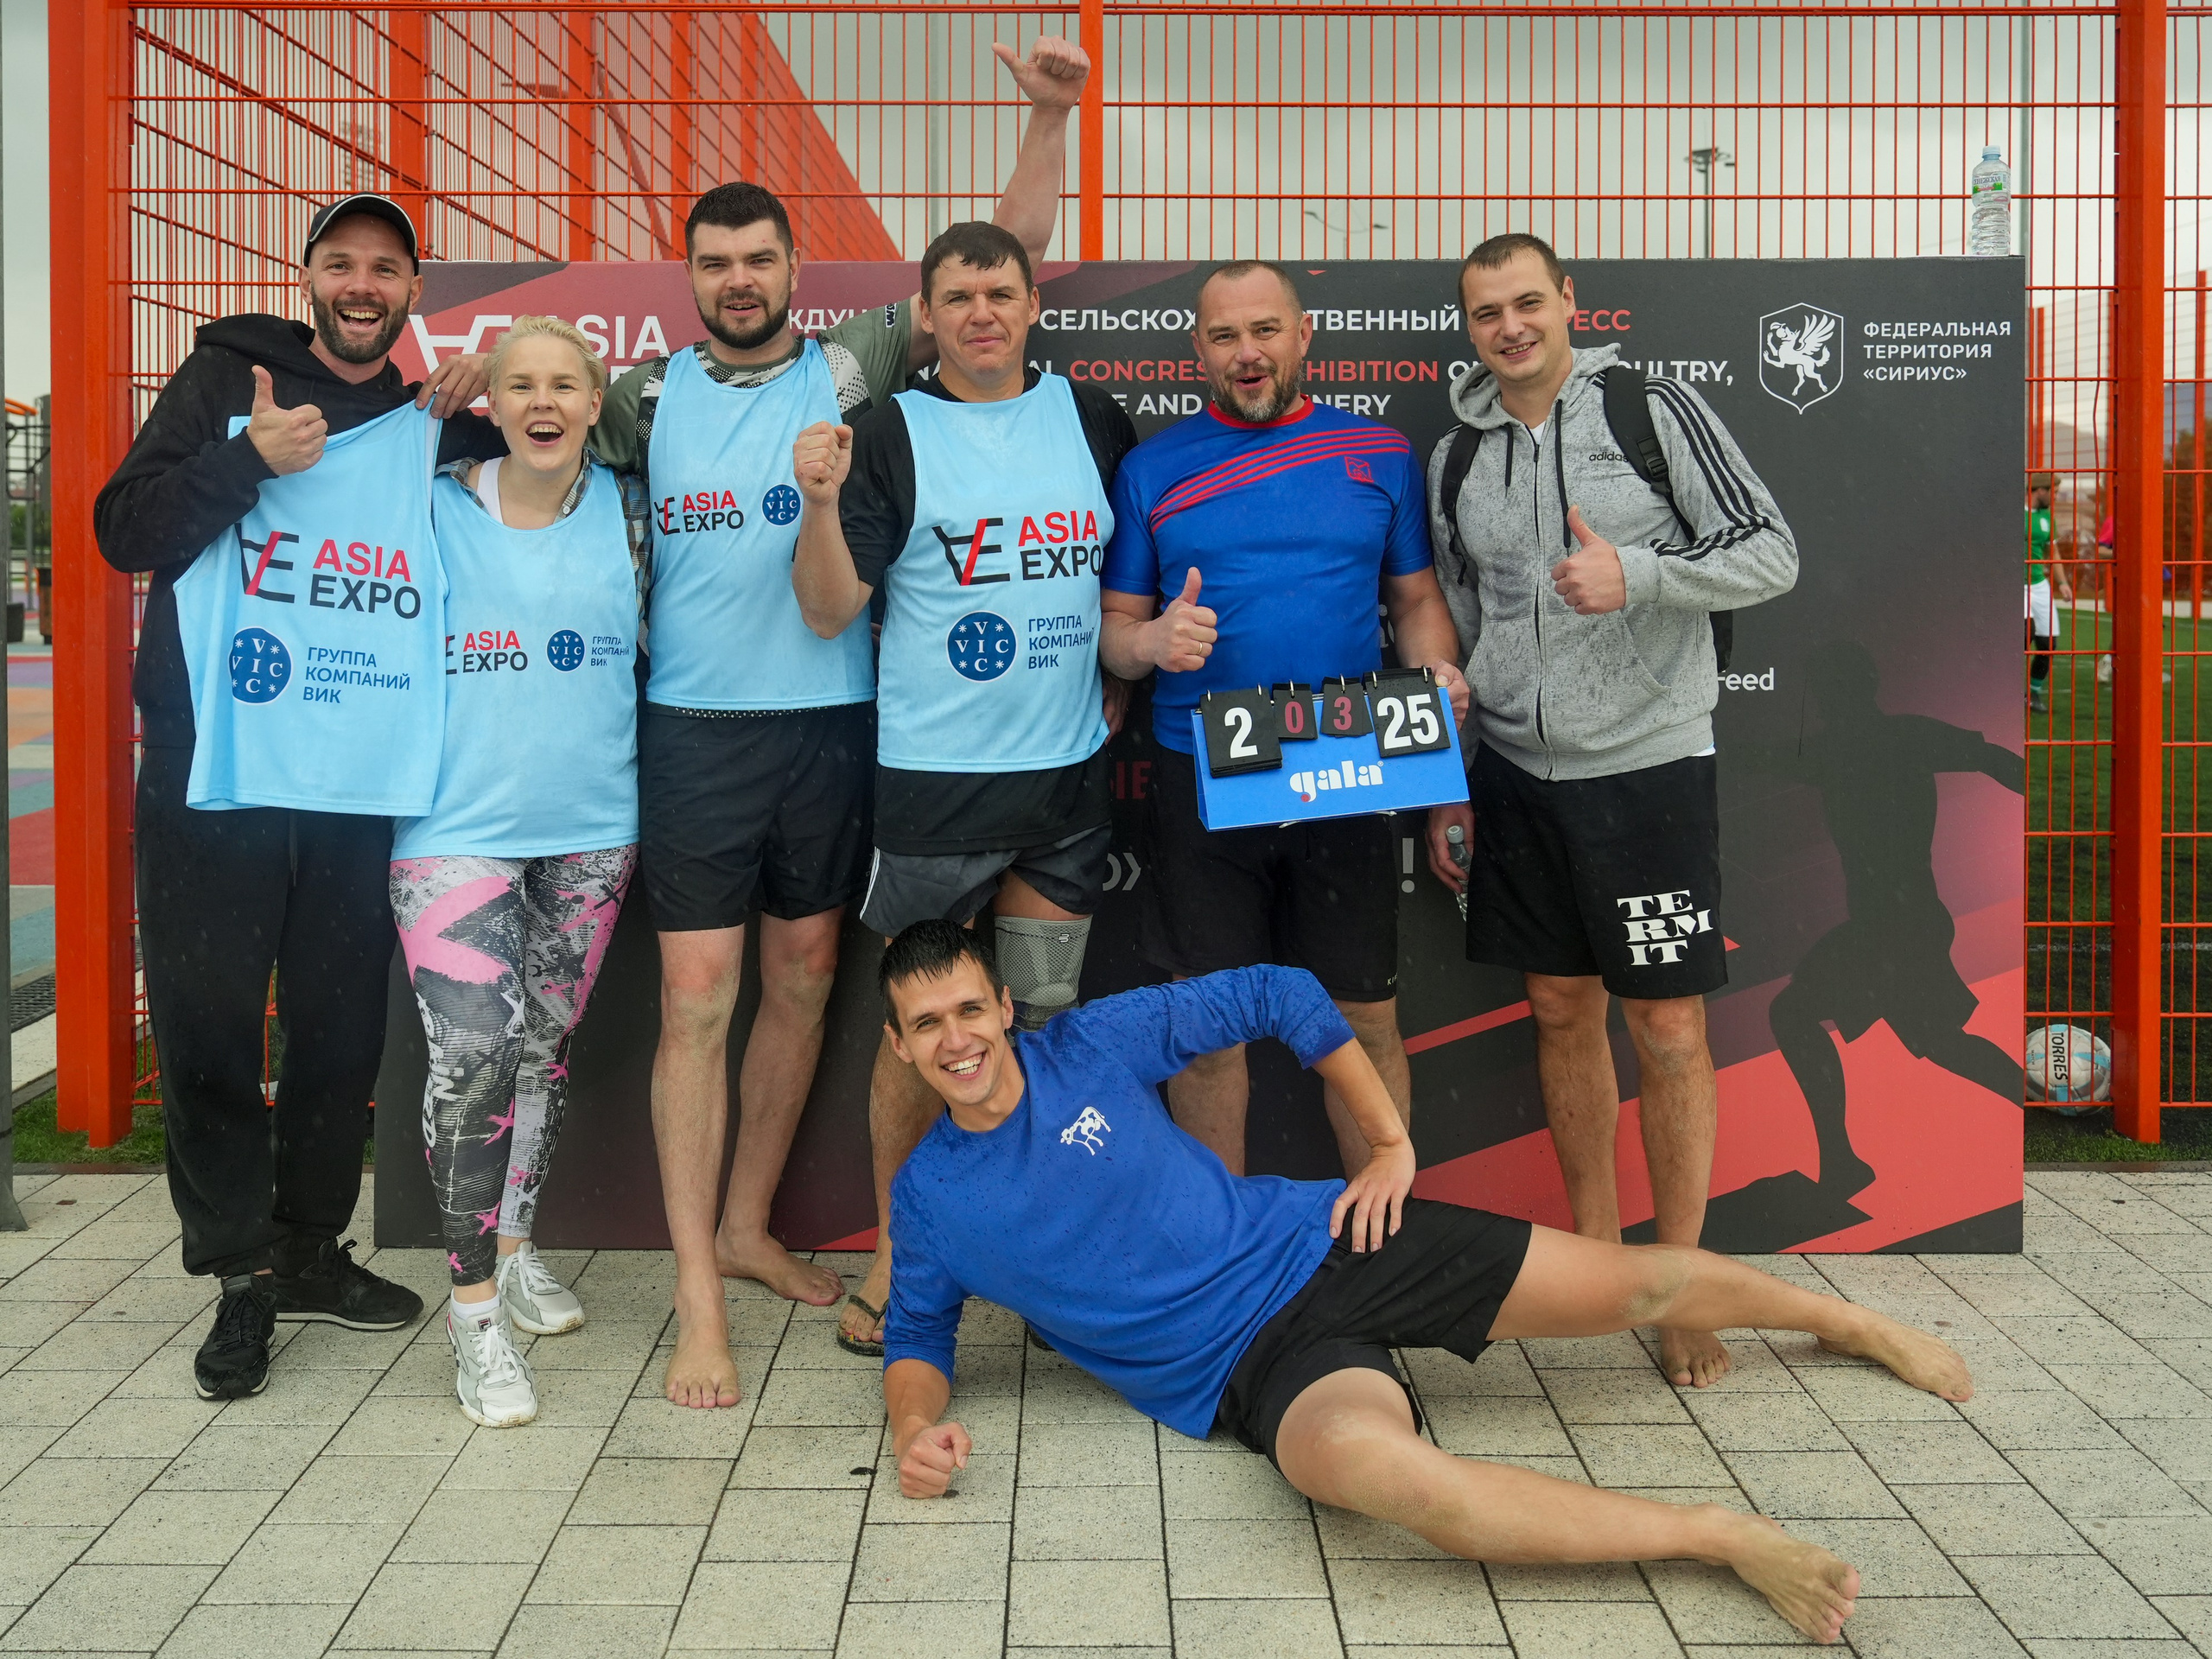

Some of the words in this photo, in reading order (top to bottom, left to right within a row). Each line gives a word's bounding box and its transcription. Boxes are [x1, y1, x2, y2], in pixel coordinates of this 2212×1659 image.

[550, 315, 670, 359] SIA
[1863, 321, 2011, 340] ФЕДЕРАЛЬНАЯ
[1863, 343, 1992, 359] ТЕРРИТОРИЯ
[1301, 359, 1438, 382] HIBITION
[1863, 365, 1967, 381] «СИРИУС»
[1135, 393, 1203, 416] AND
[683, 489, 737, 513] ASIA
[683, 510, 745, 533] EXPO
[1018, 510, 1099, 547] ASIA
[312, 538, 411, 582] ASIA
[1020, 544, 1102, 581] EXPO
[308, 574, 422, 620] EXPO
[1028, 614, 1083, 632] ГРУППА
[462, 630, 521, 652] ASIA
[592, 636, 622, 646] ГРУППА
[1028, 627, 1095, 651] КОМПАНИЙ
[307, 646, 378, 668] ГРУППА
[462, 651, 529, 673] EXPO
[590, 658, 608, 667] ВИК
[1028, 653, 1059, 670] ВИК
[305, 665, 411, 691] КОМПАНИЙ
[302, 686, 342, 704] ВИК
[1224, 707, 1258, 759] 2
[1284, 701, 1305, 734] 0
[1333, 696, 1352, 731] 3
[1376, 694, 1440, 750] 25
[1289, 760, 1383, 803] gala
[1617, 889, 1694, 918] TE
[1622, 909, 1713, 943] RM
[1627, 939, 1688, 966] IT
[2051, 1033, 2069, 1081] TORRES
